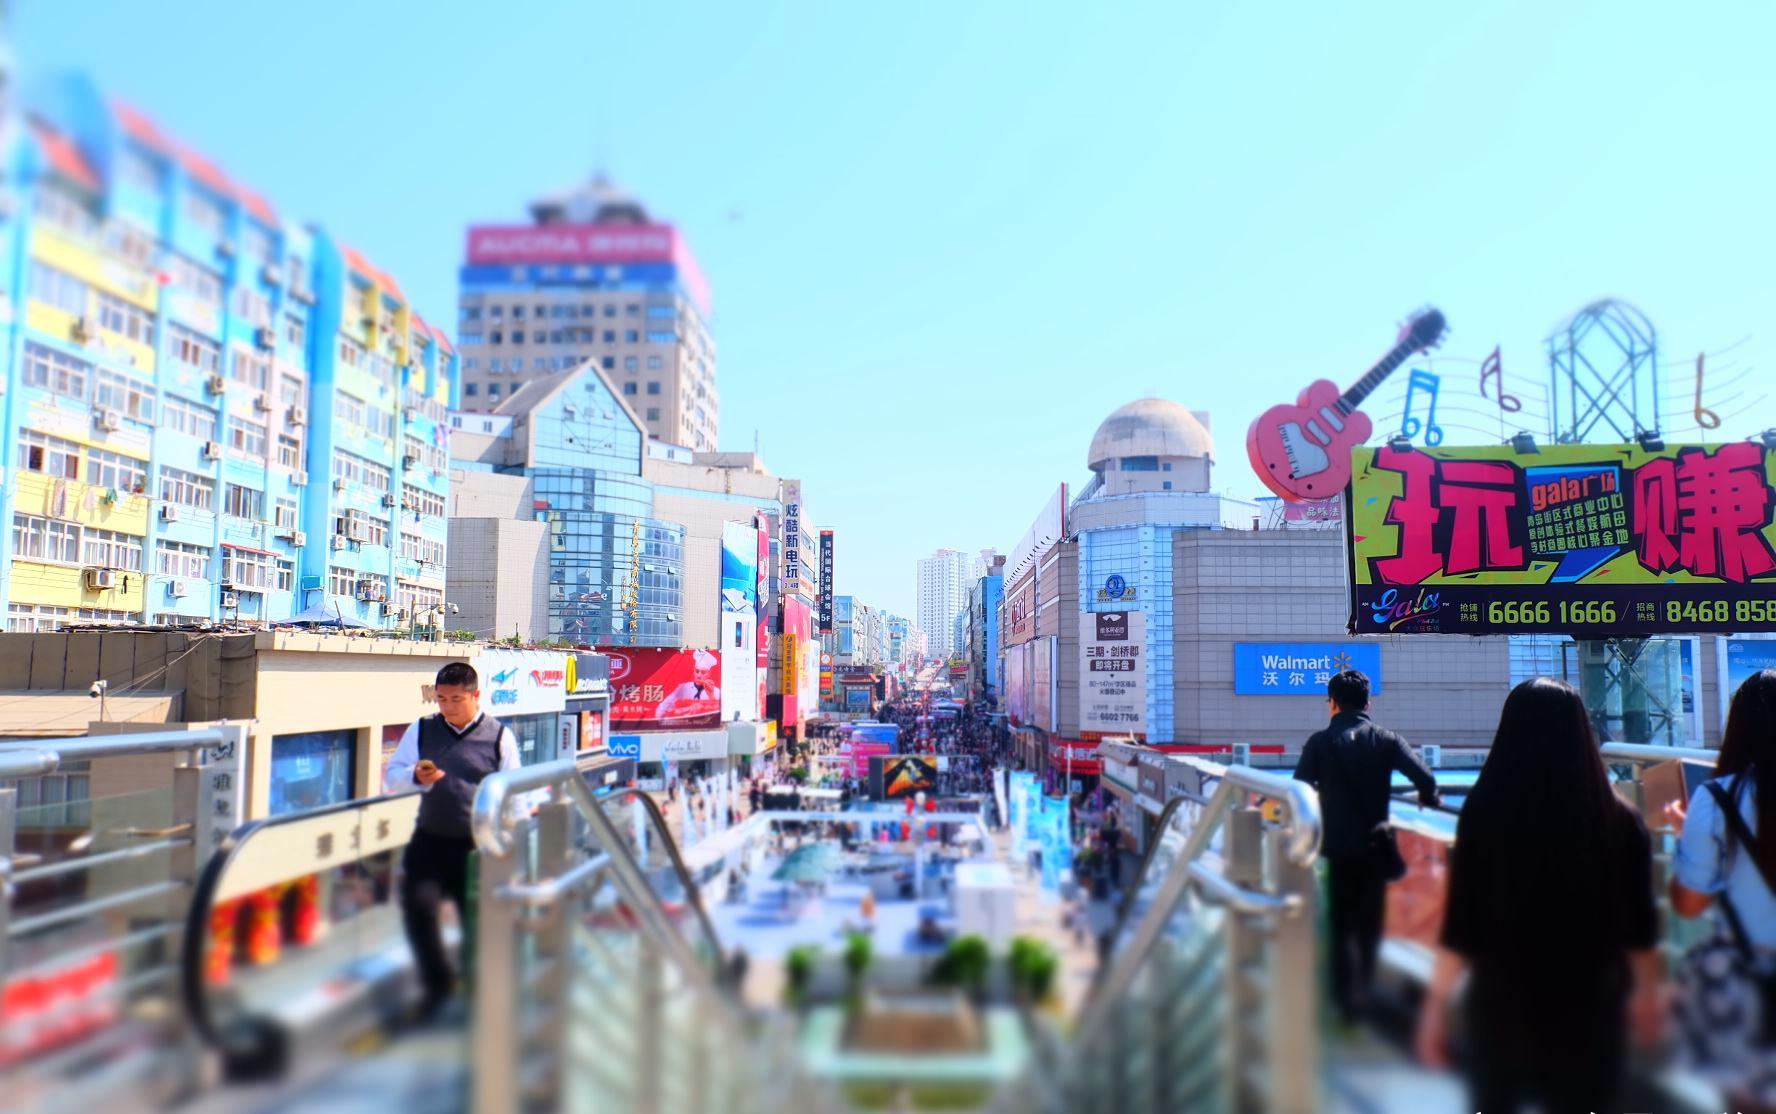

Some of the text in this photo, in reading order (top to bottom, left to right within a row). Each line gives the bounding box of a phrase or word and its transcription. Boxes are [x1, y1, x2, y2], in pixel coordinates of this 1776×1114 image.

[1376, 442, 1776, 585] 玩 赚
[785, 503, 799, 579] 炫酷新电玩
[824, 540, 832, 610] 当代国际台球会馆
[1488, 600, 1617, 624] 6666 1666
[1636, 602, 1655, 612] 招商
[1666, 600, 1729, 622] 8468
[1460, 612, 1479, 622] 热线
[1636, 612, 1656, 622] 热线
[1095, 660, 1130, 671] 即将开盘
[1261, 655, 1331, 670] Walmart
[1262, 671, 1329, 686] 沃尔玛
[608, 743, 639, 754] vivo
